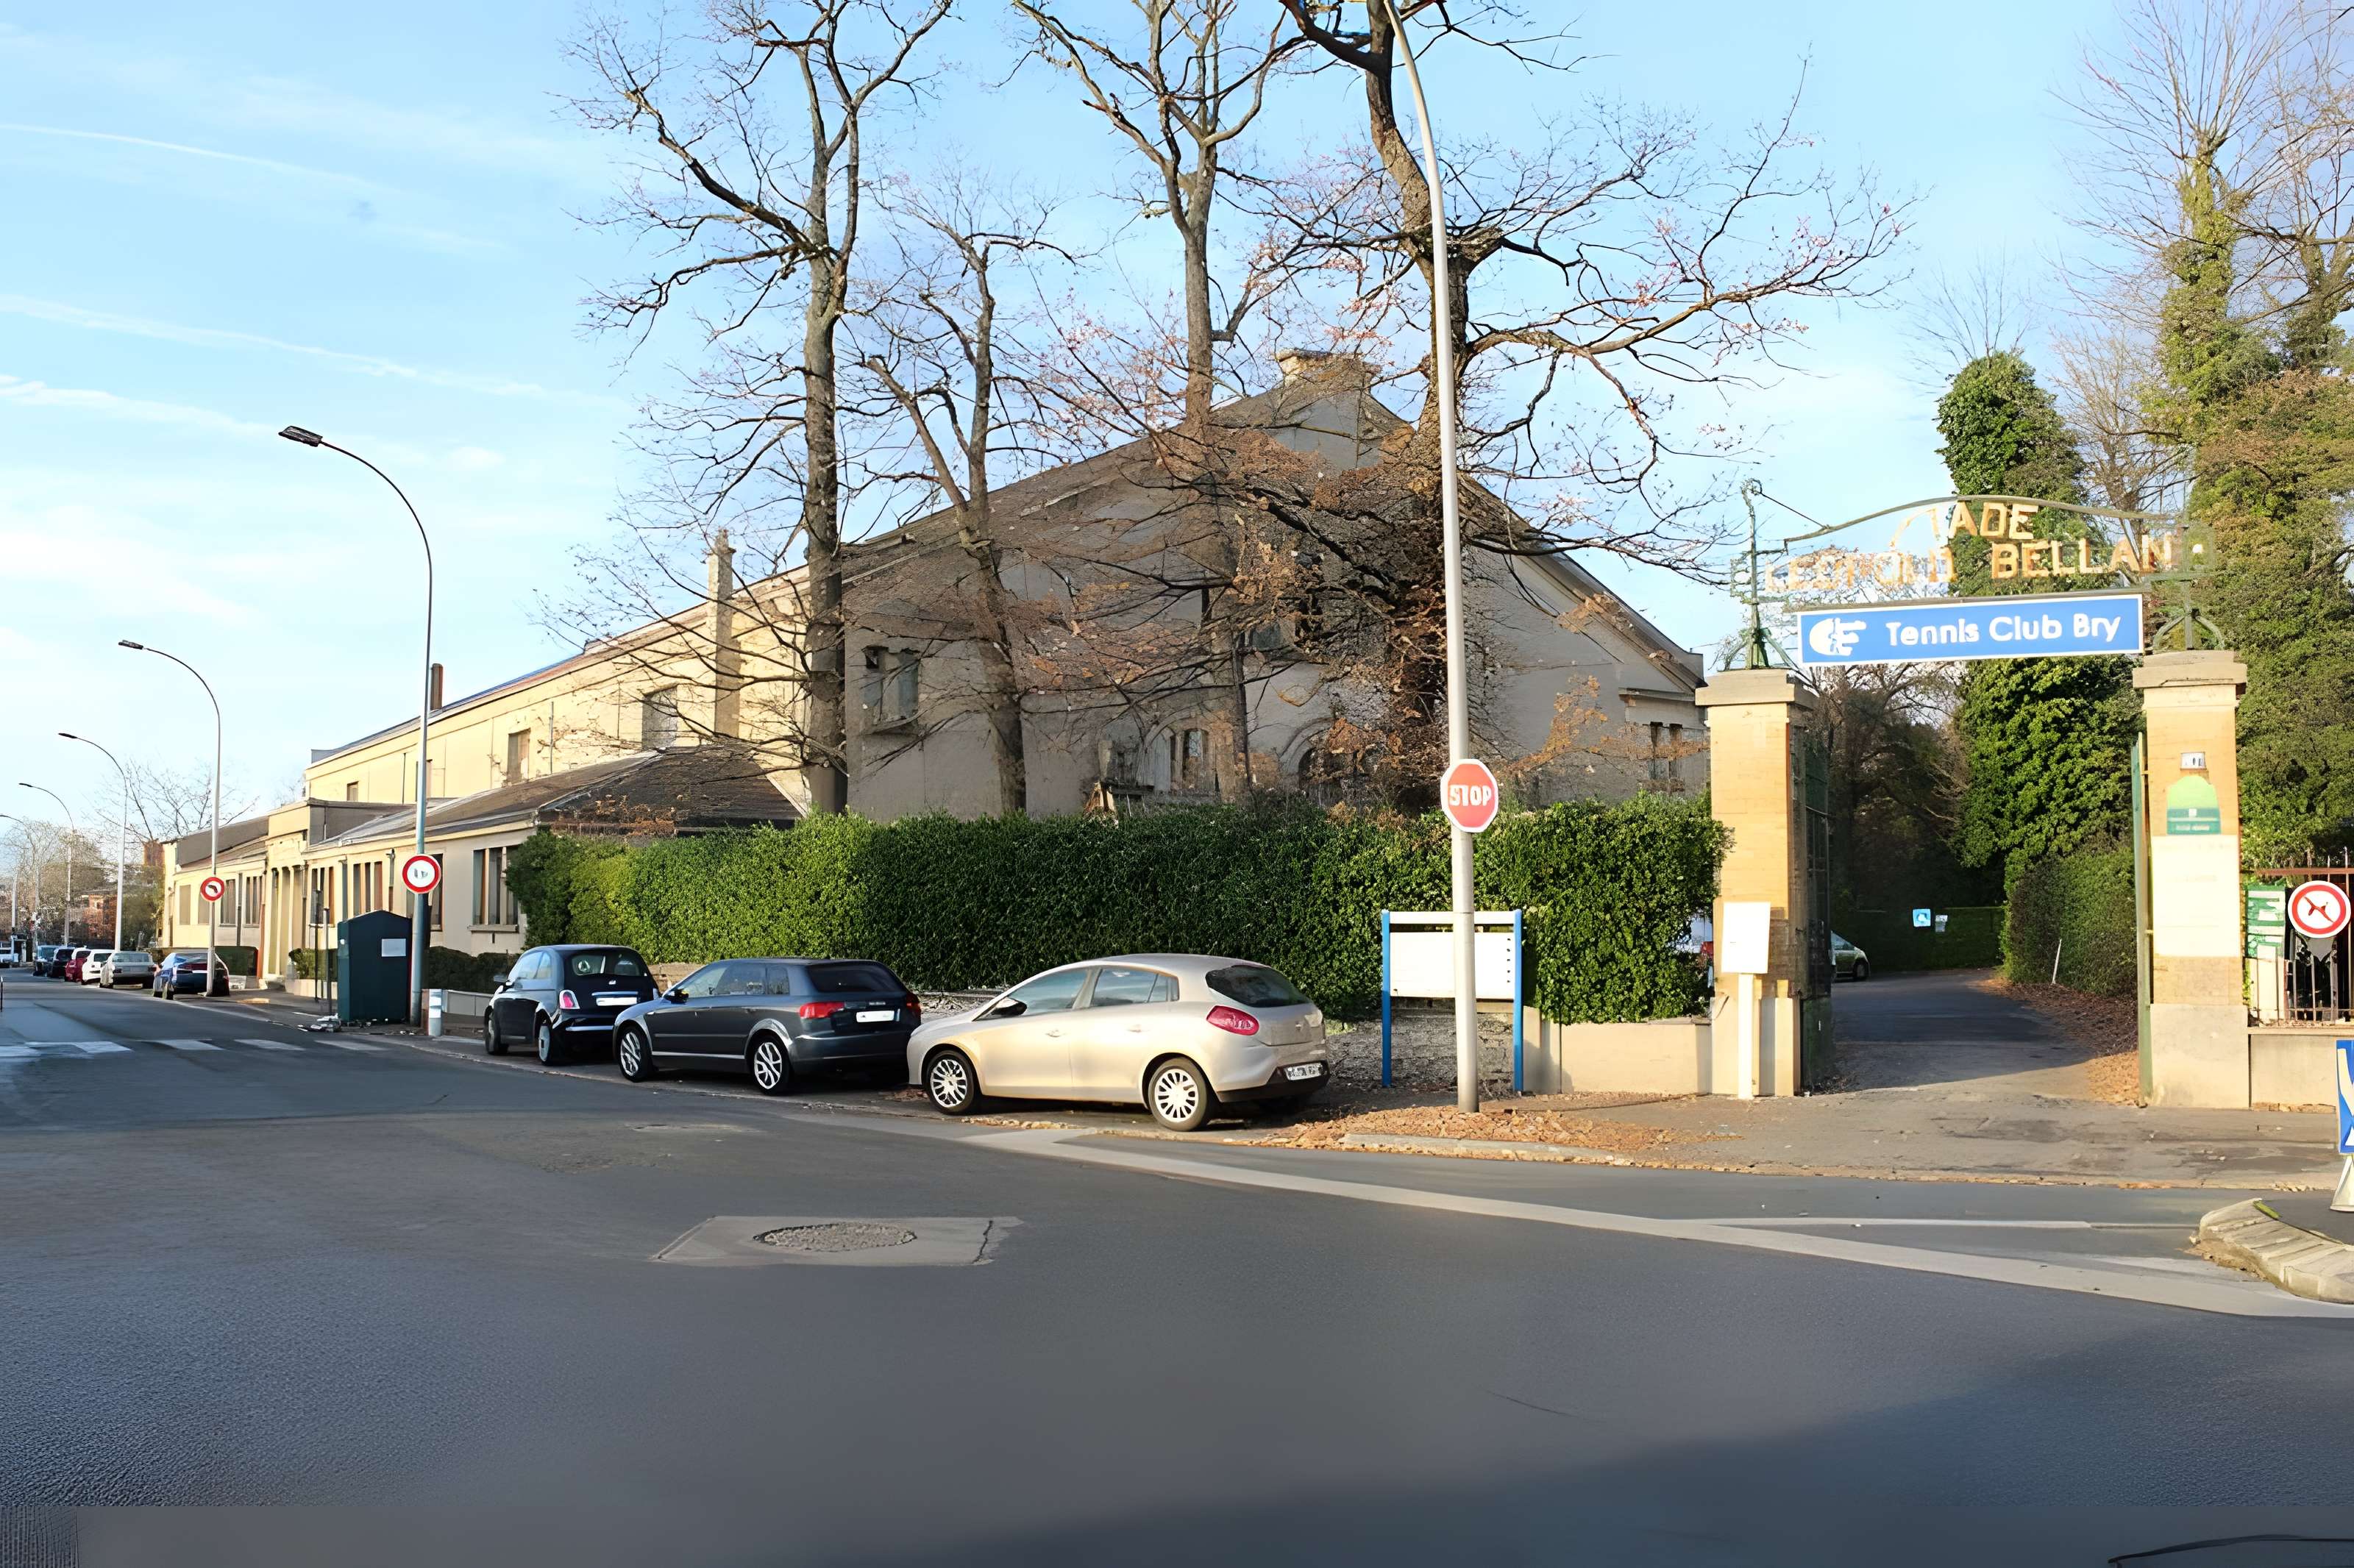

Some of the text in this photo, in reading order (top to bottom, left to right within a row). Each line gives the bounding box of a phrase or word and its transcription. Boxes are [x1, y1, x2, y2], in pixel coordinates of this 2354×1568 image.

[1991, 532, 2172, 579] BELLAN
[1885, 613, 2122, 646] Tennis Club Bry
[1448, 784, 1492, 806] STOP
